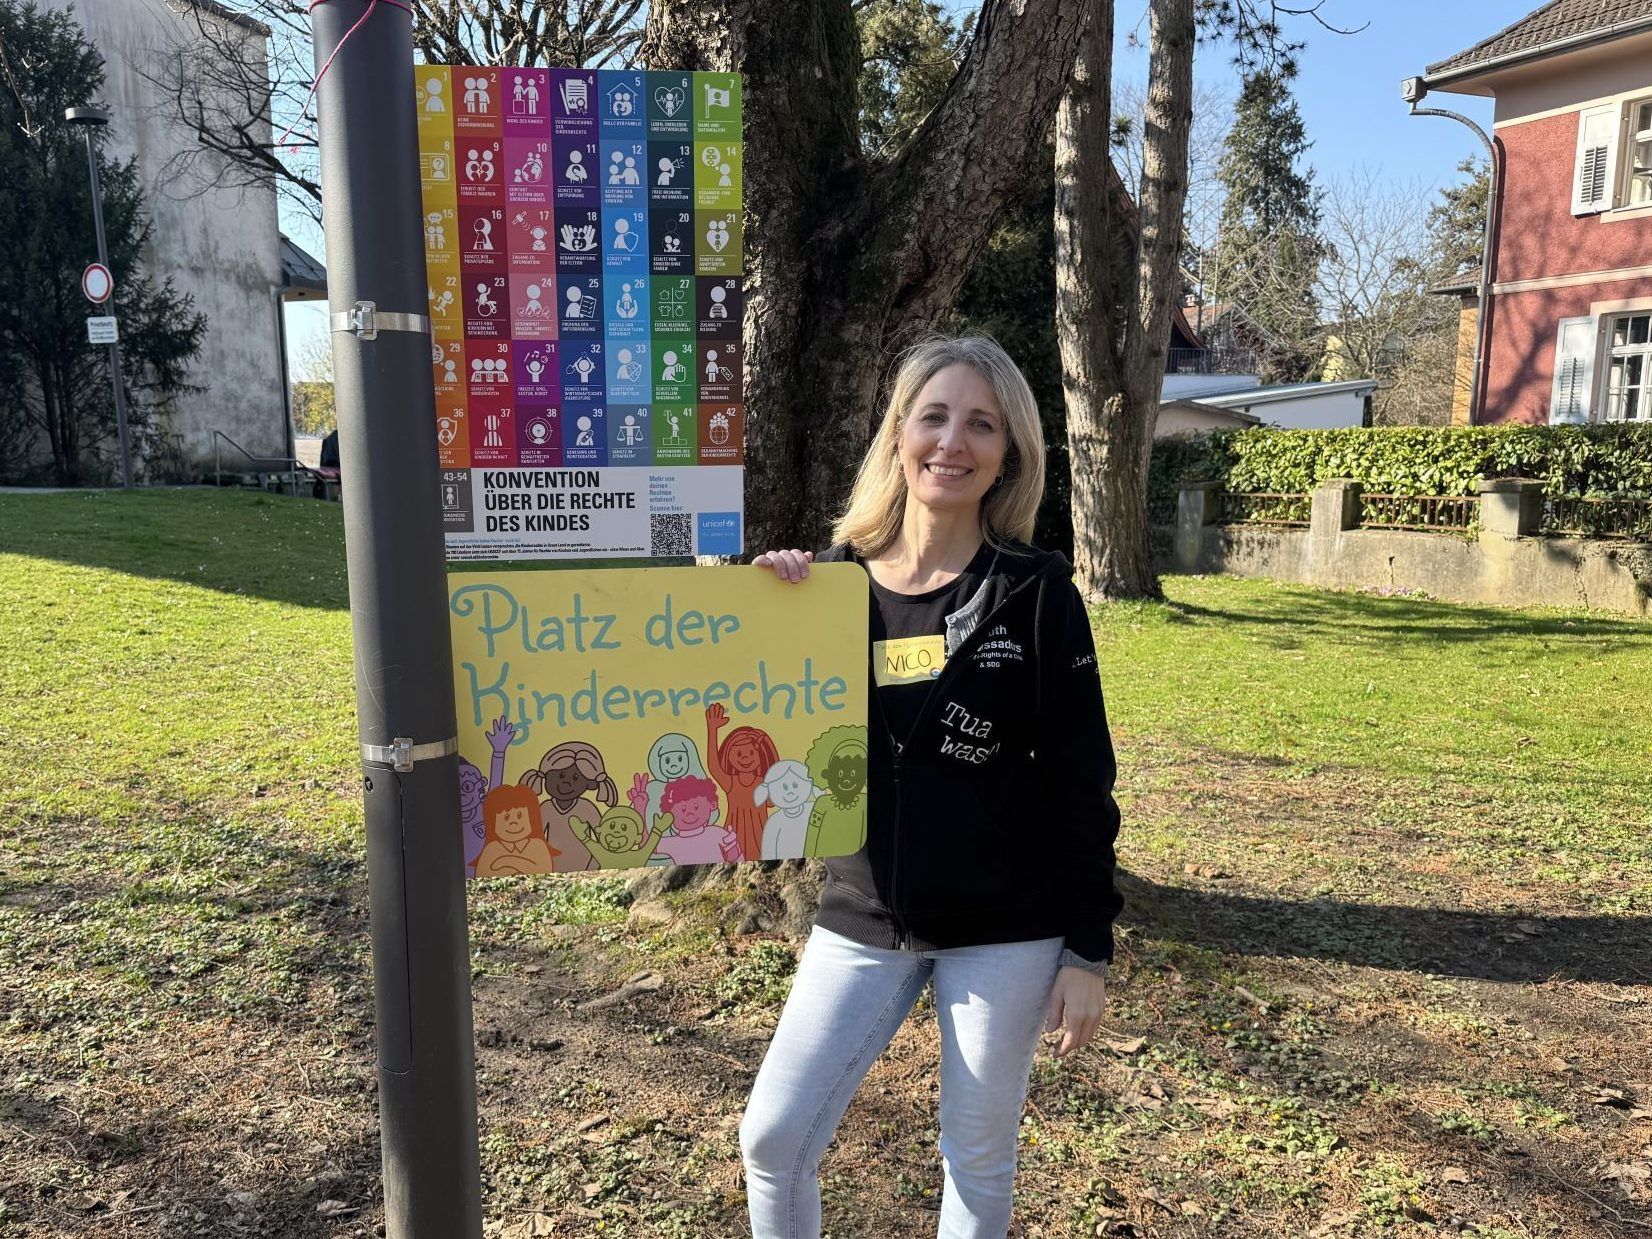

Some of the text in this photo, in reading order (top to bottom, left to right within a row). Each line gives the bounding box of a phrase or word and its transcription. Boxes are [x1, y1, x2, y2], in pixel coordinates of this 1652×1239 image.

[444, 72, 447, 82] 1
[491, 73, 496, 82] 2
[539, 74, 545, 84] 3
[588, 76, 593, 85] 4
[635, 77, 640, 86] 5
[682, 78, 688, 87] 6
[729, 79, 734, 88] 7
[444, 141, 450, 150] 8
[493, 142, 499, 151] 9
[537, 143, 547, 152] 10
[587, 144, 596, 153] 11
[632, 145, 642, 154] 12
[680, 146, 690, 155] 13
[727, 147, 736, 156] 14
[443, 209, 453, 218] 15
[492, 210, 502, 220] 16
[539, 211, 549, 220] 17
[587, 212, 597, 221] 18
[634, 213, 644, 222] 19
[679, 213, 689, 222] 20
[727, 214, 736, 223] 21
[446, 277, 456, 286] 22
[494, 278, 505, 287] 23
[542, 278, 552, 287] 24
[588, 279, 599, 288] 25
[635, 279, 645, 288] 26
[680, 280, 690, 288] 27
[726, 280, 736, 289] 28
[450, 344, 460, 352] 29
[498, 344, 508, 353] 30
[545, 344, 555, 353] 31
[591, 344, 600, 353] 32
[636, 344, 646, 353] 33
[682, 344, 692, 353] 34
[726, 344, 736, 353] 35
[453, 409, 464, 418] 36
[501, 409, 510, 417] 37
[547, 409, 556, 418] 38
[593, 408, 602, 417] 39
[638, 408, 647, 417] 40
[683, 408, 692, 416] 41
[726, 408, 736, 416] 42
[443, 472, 467, 481] 43-54
[483, 471, 600, 488] KONVENTION
[485, 490, 635, 510] ÜBER DIE RECHTE
[486, 515, 520, 532] DES
[526, 514, 590, 532] KINDES
[450, 584, 740, 658] Platz der
[886, 649, 931, 673] NICO
[461, 658, 847, 746] Kinderrechte
[940, 702, 992, 738] Tua
